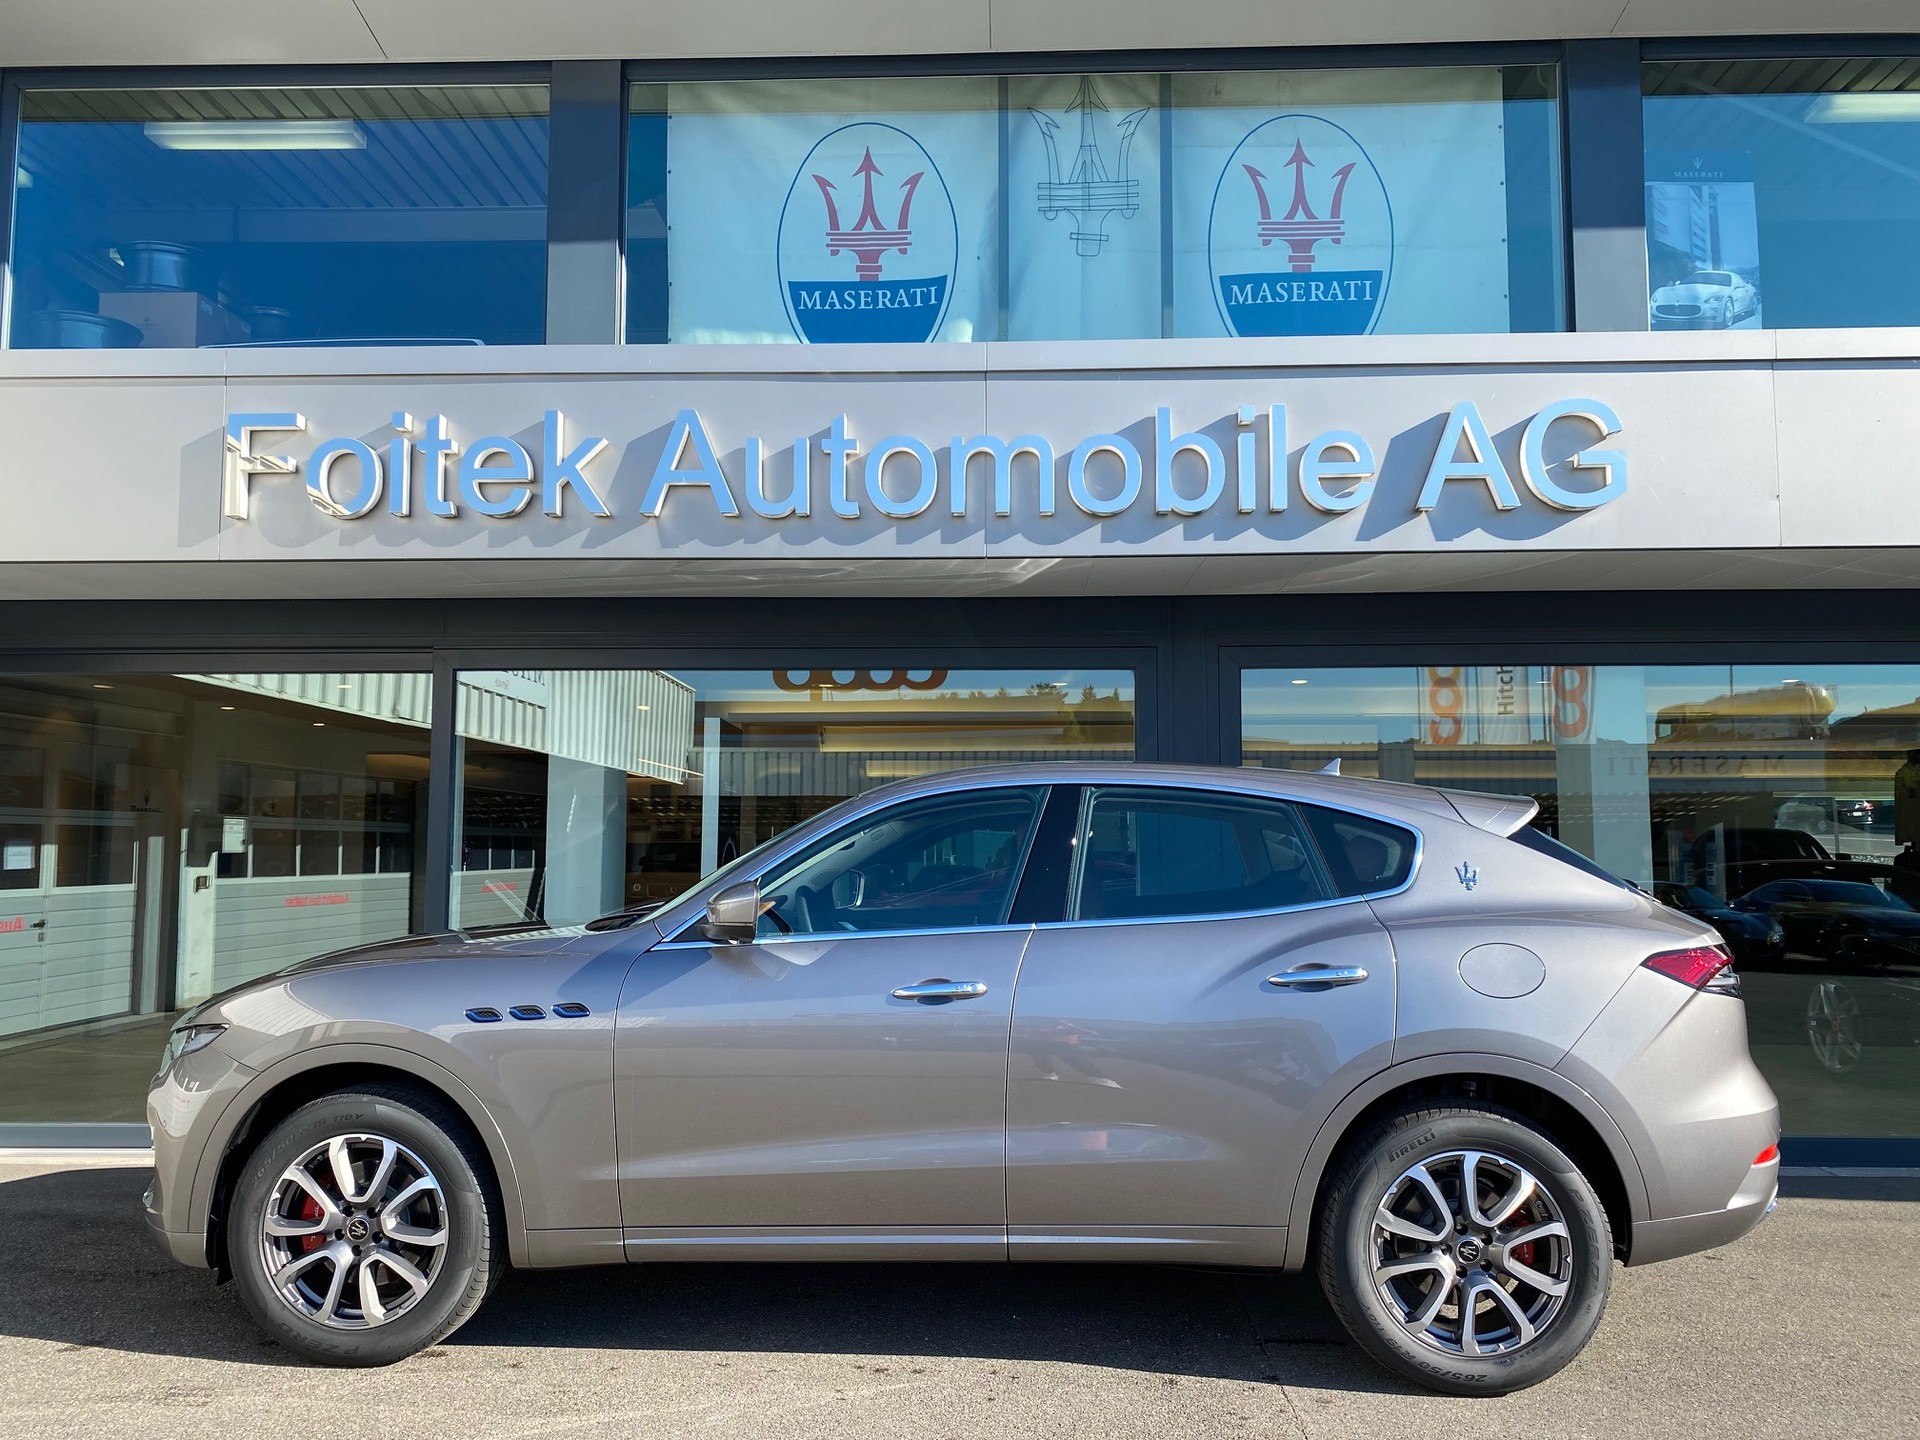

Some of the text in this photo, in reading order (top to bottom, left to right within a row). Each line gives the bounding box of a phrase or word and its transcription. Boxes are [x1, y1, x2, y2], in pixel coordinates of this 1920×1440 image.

[797, 285, 938, 310] MASERATI
[1229, 280, 1373, 306] MASERATI
[223, 398, 1630, 521] Foitek Automobile AG
[1387, 1127, 1436, 1163] PIRELLI
[1417, 1360, 1489, 1384] 265/50
